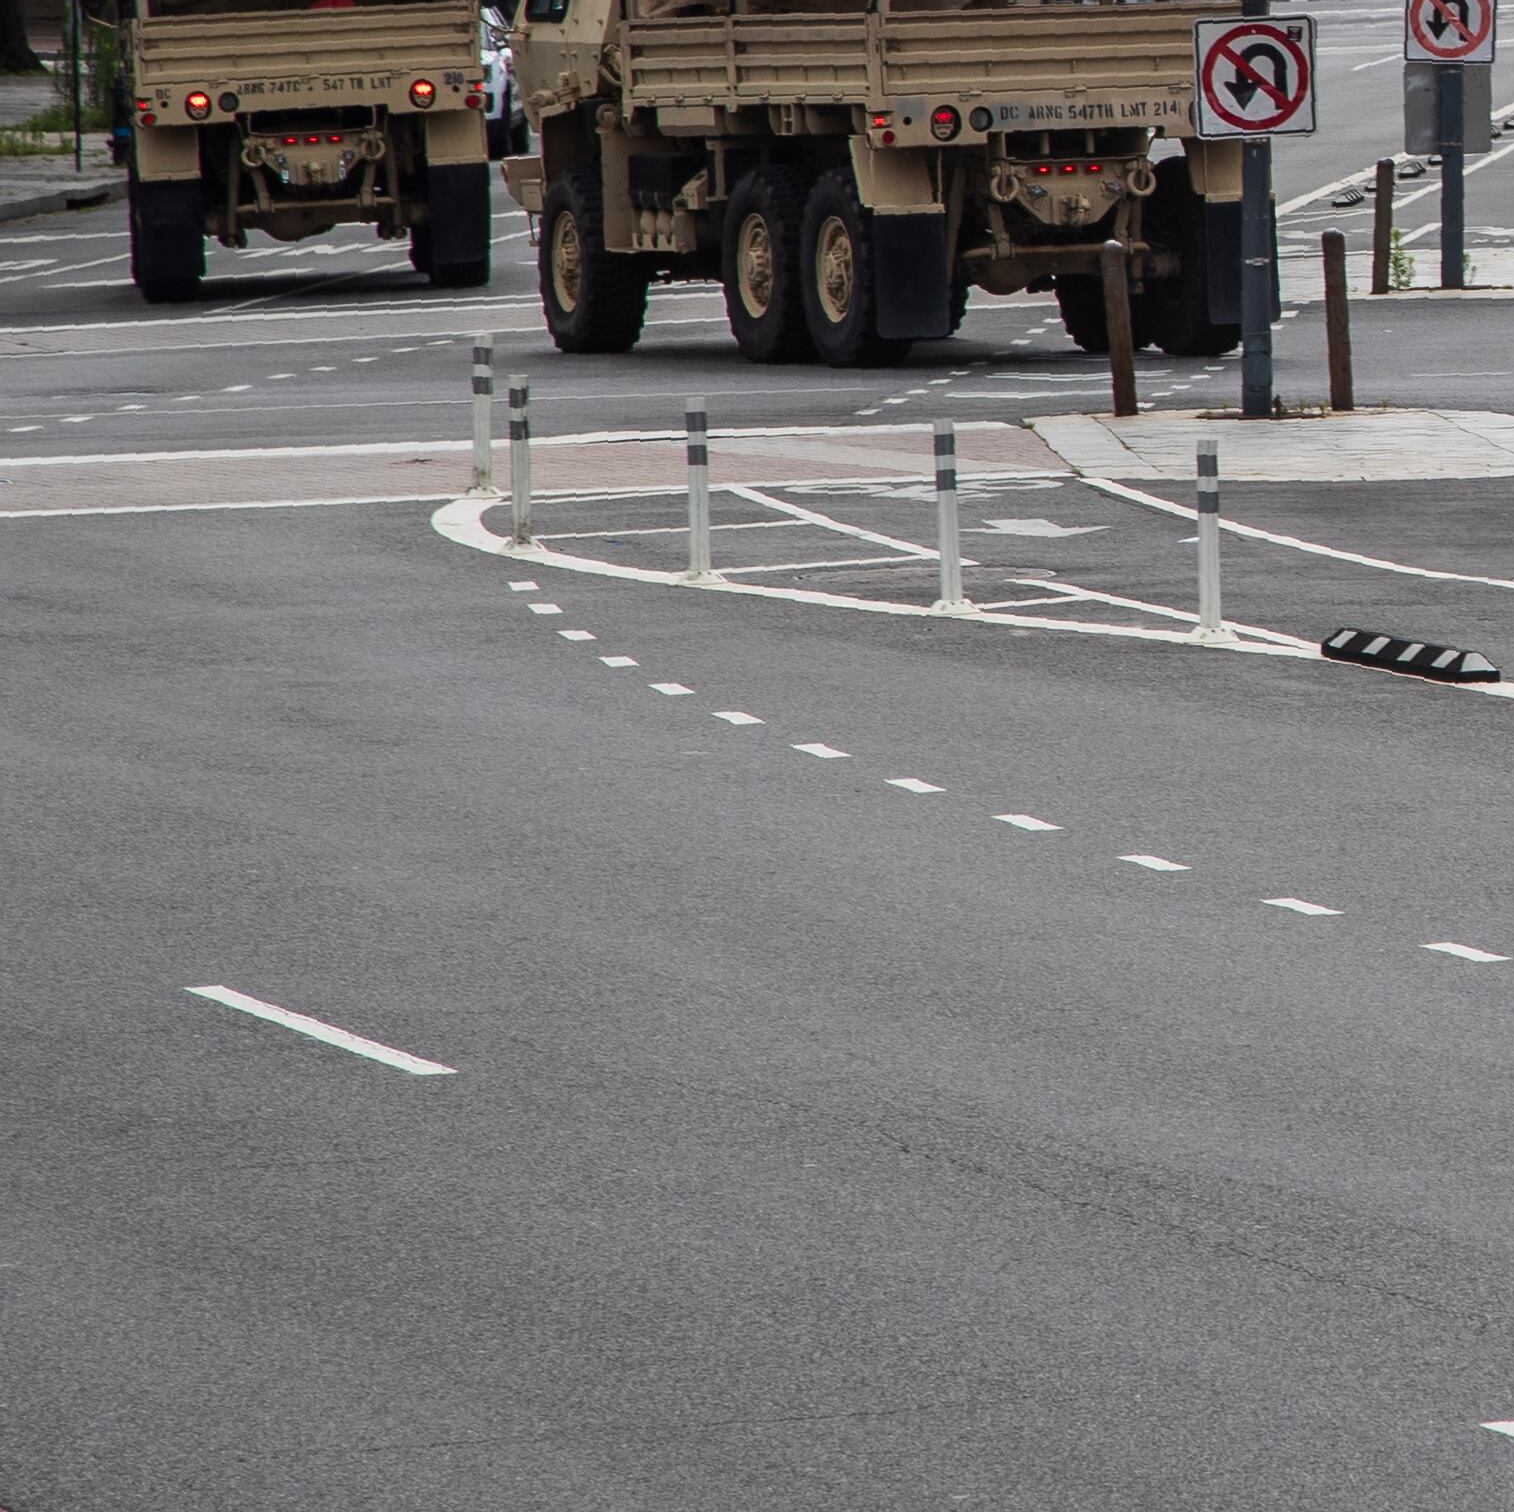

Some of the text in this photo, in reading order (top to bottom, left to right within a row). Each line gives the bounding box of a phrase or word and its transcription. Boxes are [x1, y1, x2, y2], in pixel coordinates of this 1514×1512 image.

[156, 88, 170, 101] DC
[323, 79, 345, 91] 547
[1000, 106, 1019, 121] DC
[1028, 104, 1063, 121] ARNG
[1068, 104, 1114, 120] 547TH
[1121, 102, 1147, 119] LMT
